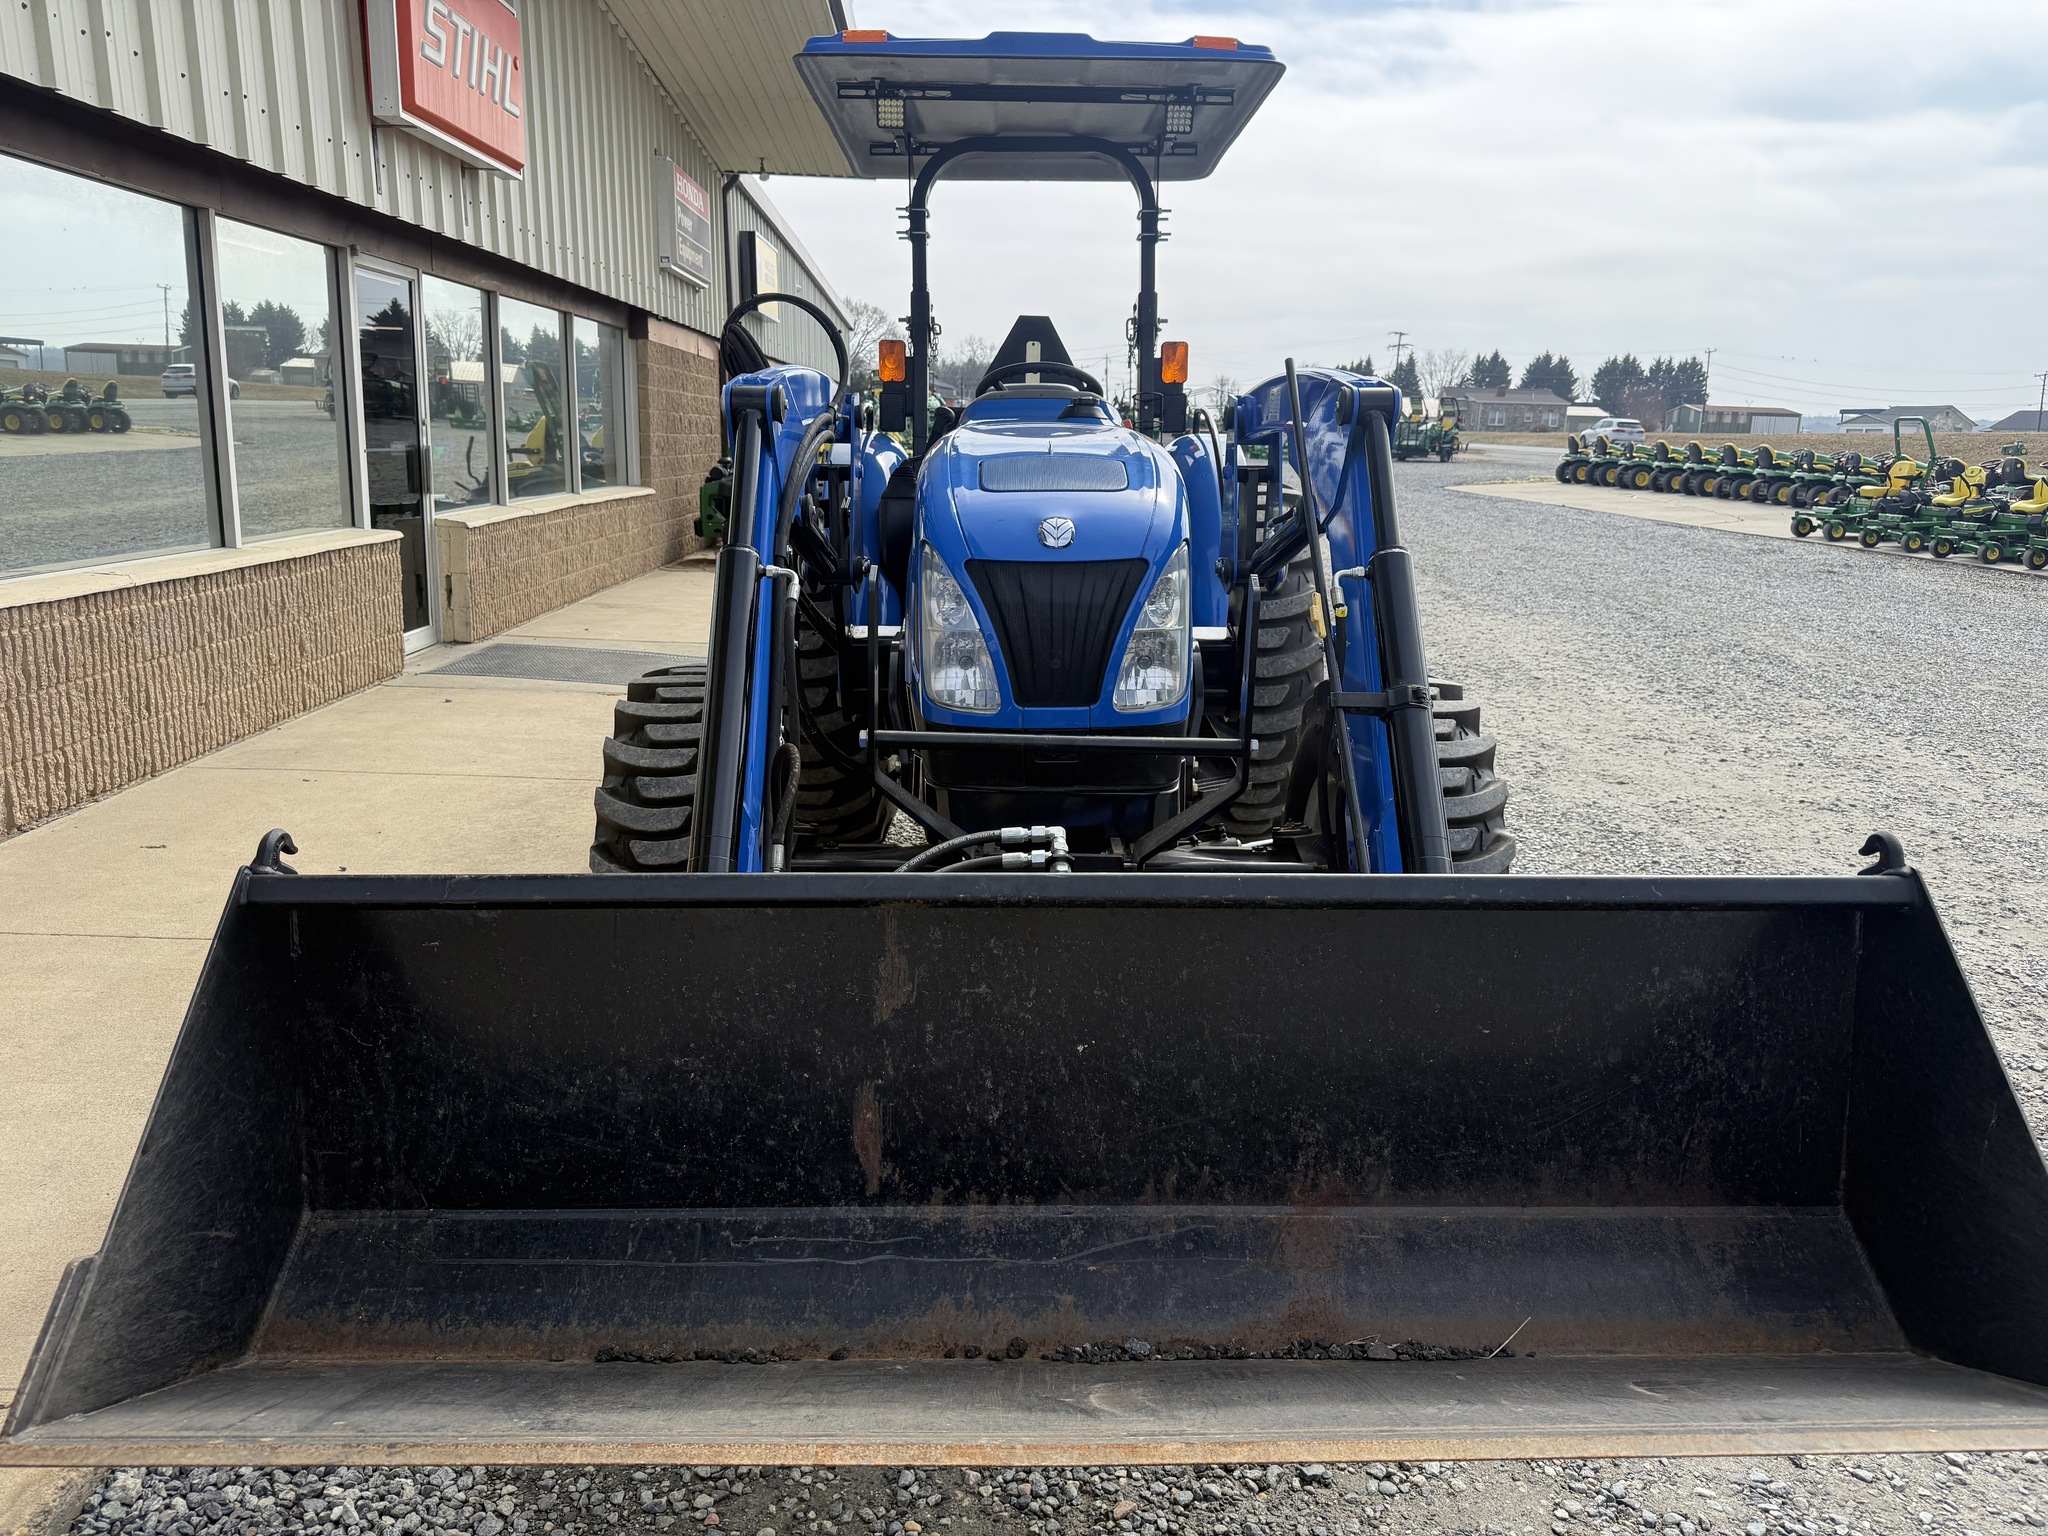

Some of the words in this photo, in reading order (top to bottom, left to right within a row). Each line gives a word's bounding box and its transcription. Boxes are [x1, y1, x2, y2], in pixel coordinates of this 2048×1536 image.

[419, 0, 520, 119] STIHL
[676, 172, 704, 212] HONDA
[677, 204, 693, 233] Power
[678, 236, 704, 269] Equipment
